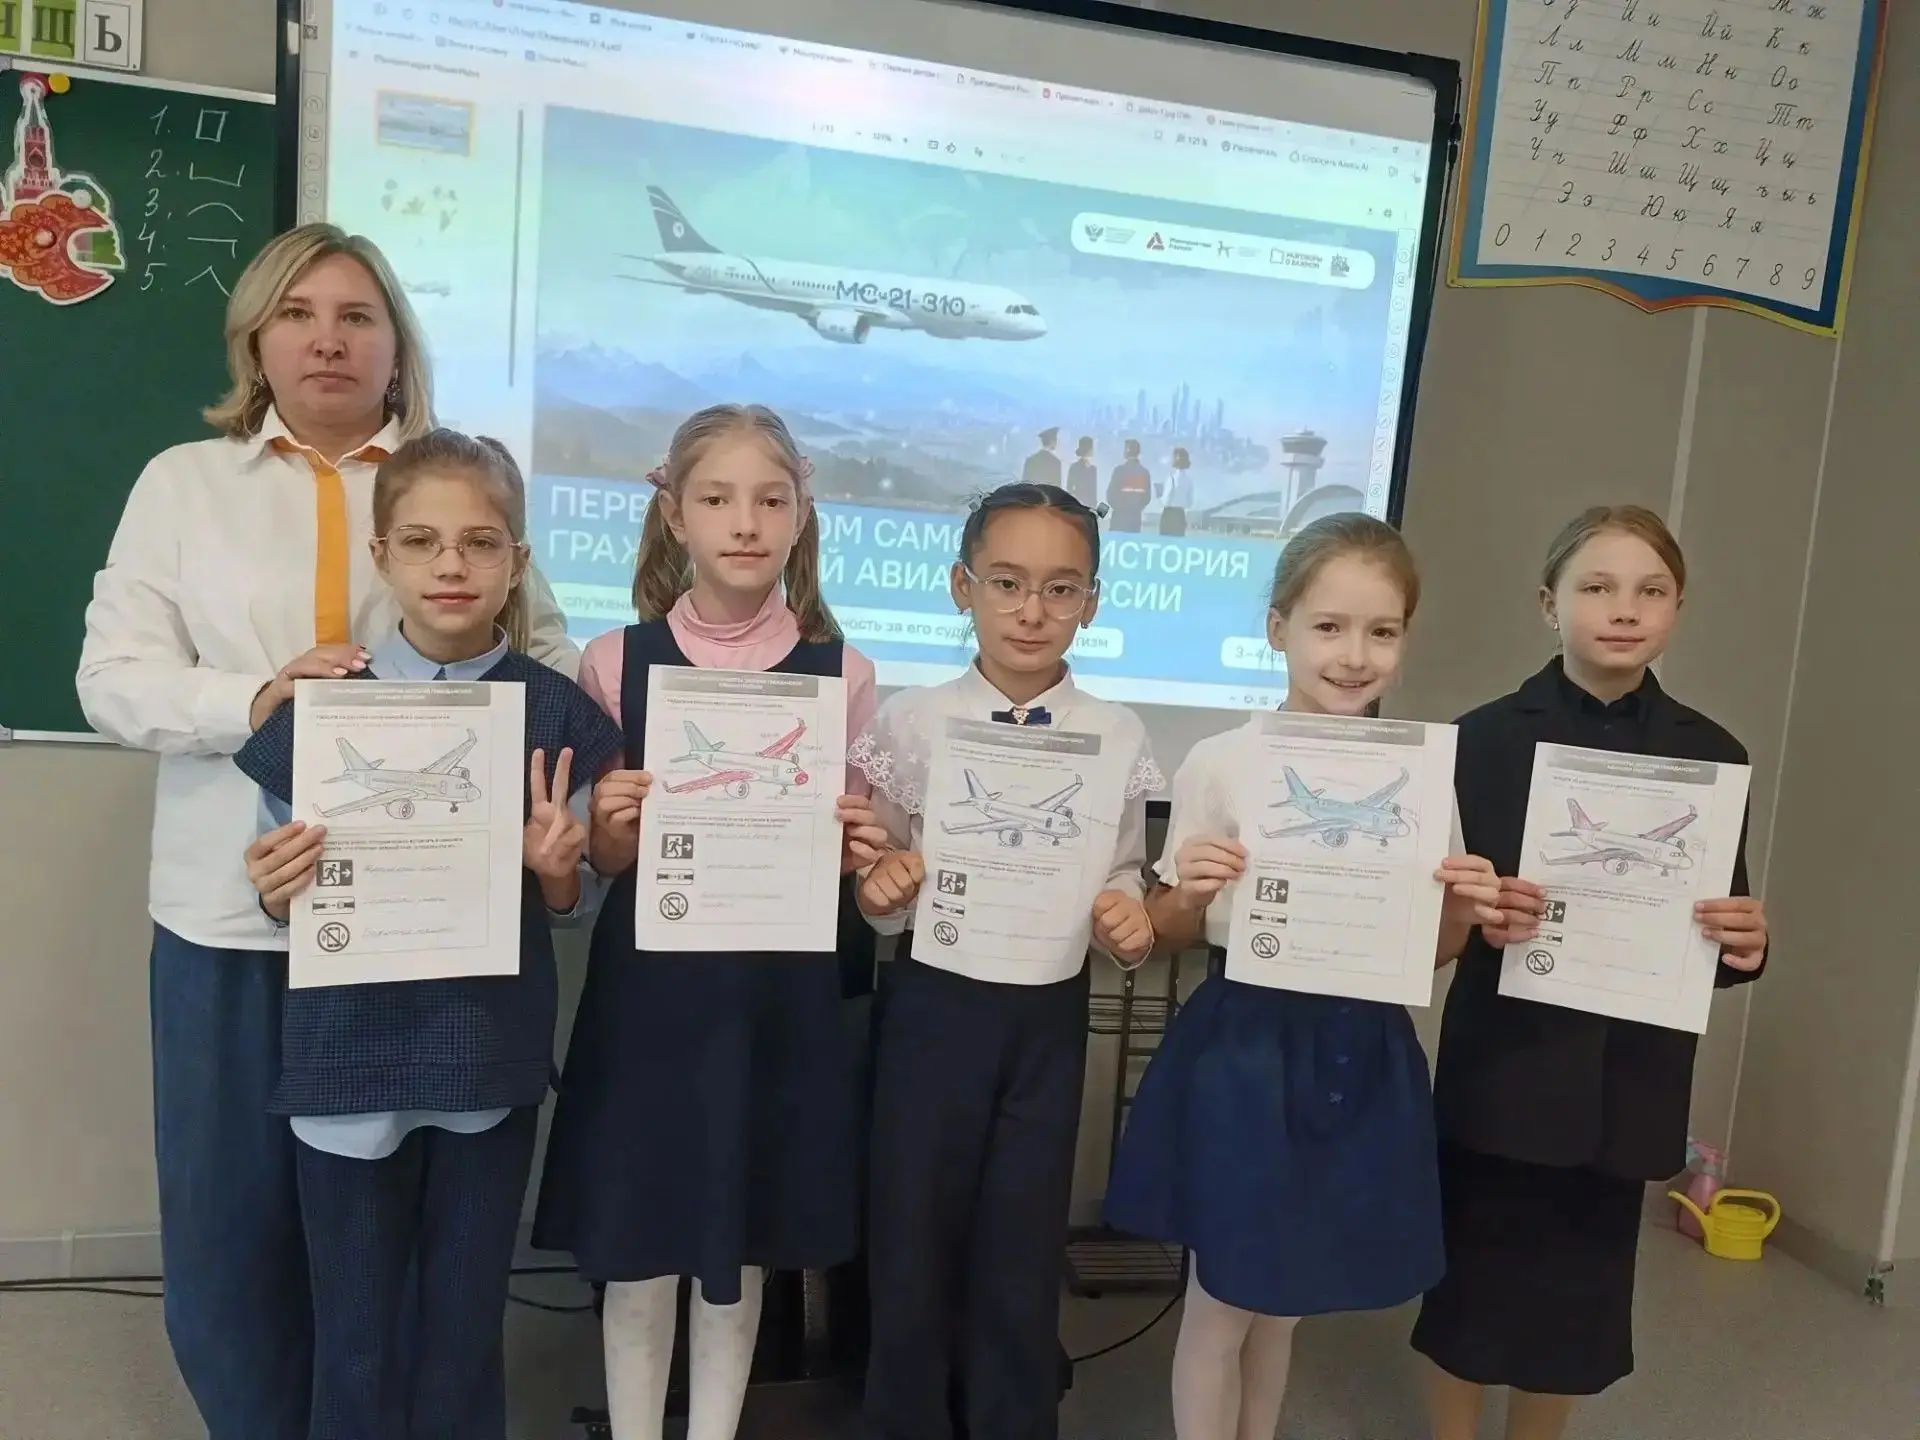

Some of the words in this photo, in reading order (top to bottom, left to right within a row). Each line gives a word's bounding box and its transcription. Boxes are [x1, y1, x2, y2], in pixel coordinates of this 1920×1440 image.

[1494, 223, 1511, 246] 0
[1535, 228, 1547, 251] 1
[1566, 233, 1582, 256] 2
[1601, 238, 1616, 261] 3
[1637, 246, 1650, 267] 4
[1666, 248, 1685, 271] 5
[1702, 254, 1718, 276] 6
[1736, 258, 1751, 280] 7
[1769, 263, 1784, 286] 8
[1801, 267, 1816, 290] 9
[550, 484, 649, 523] ПЕРВ
[854, 556, 951, 593] АВИА
